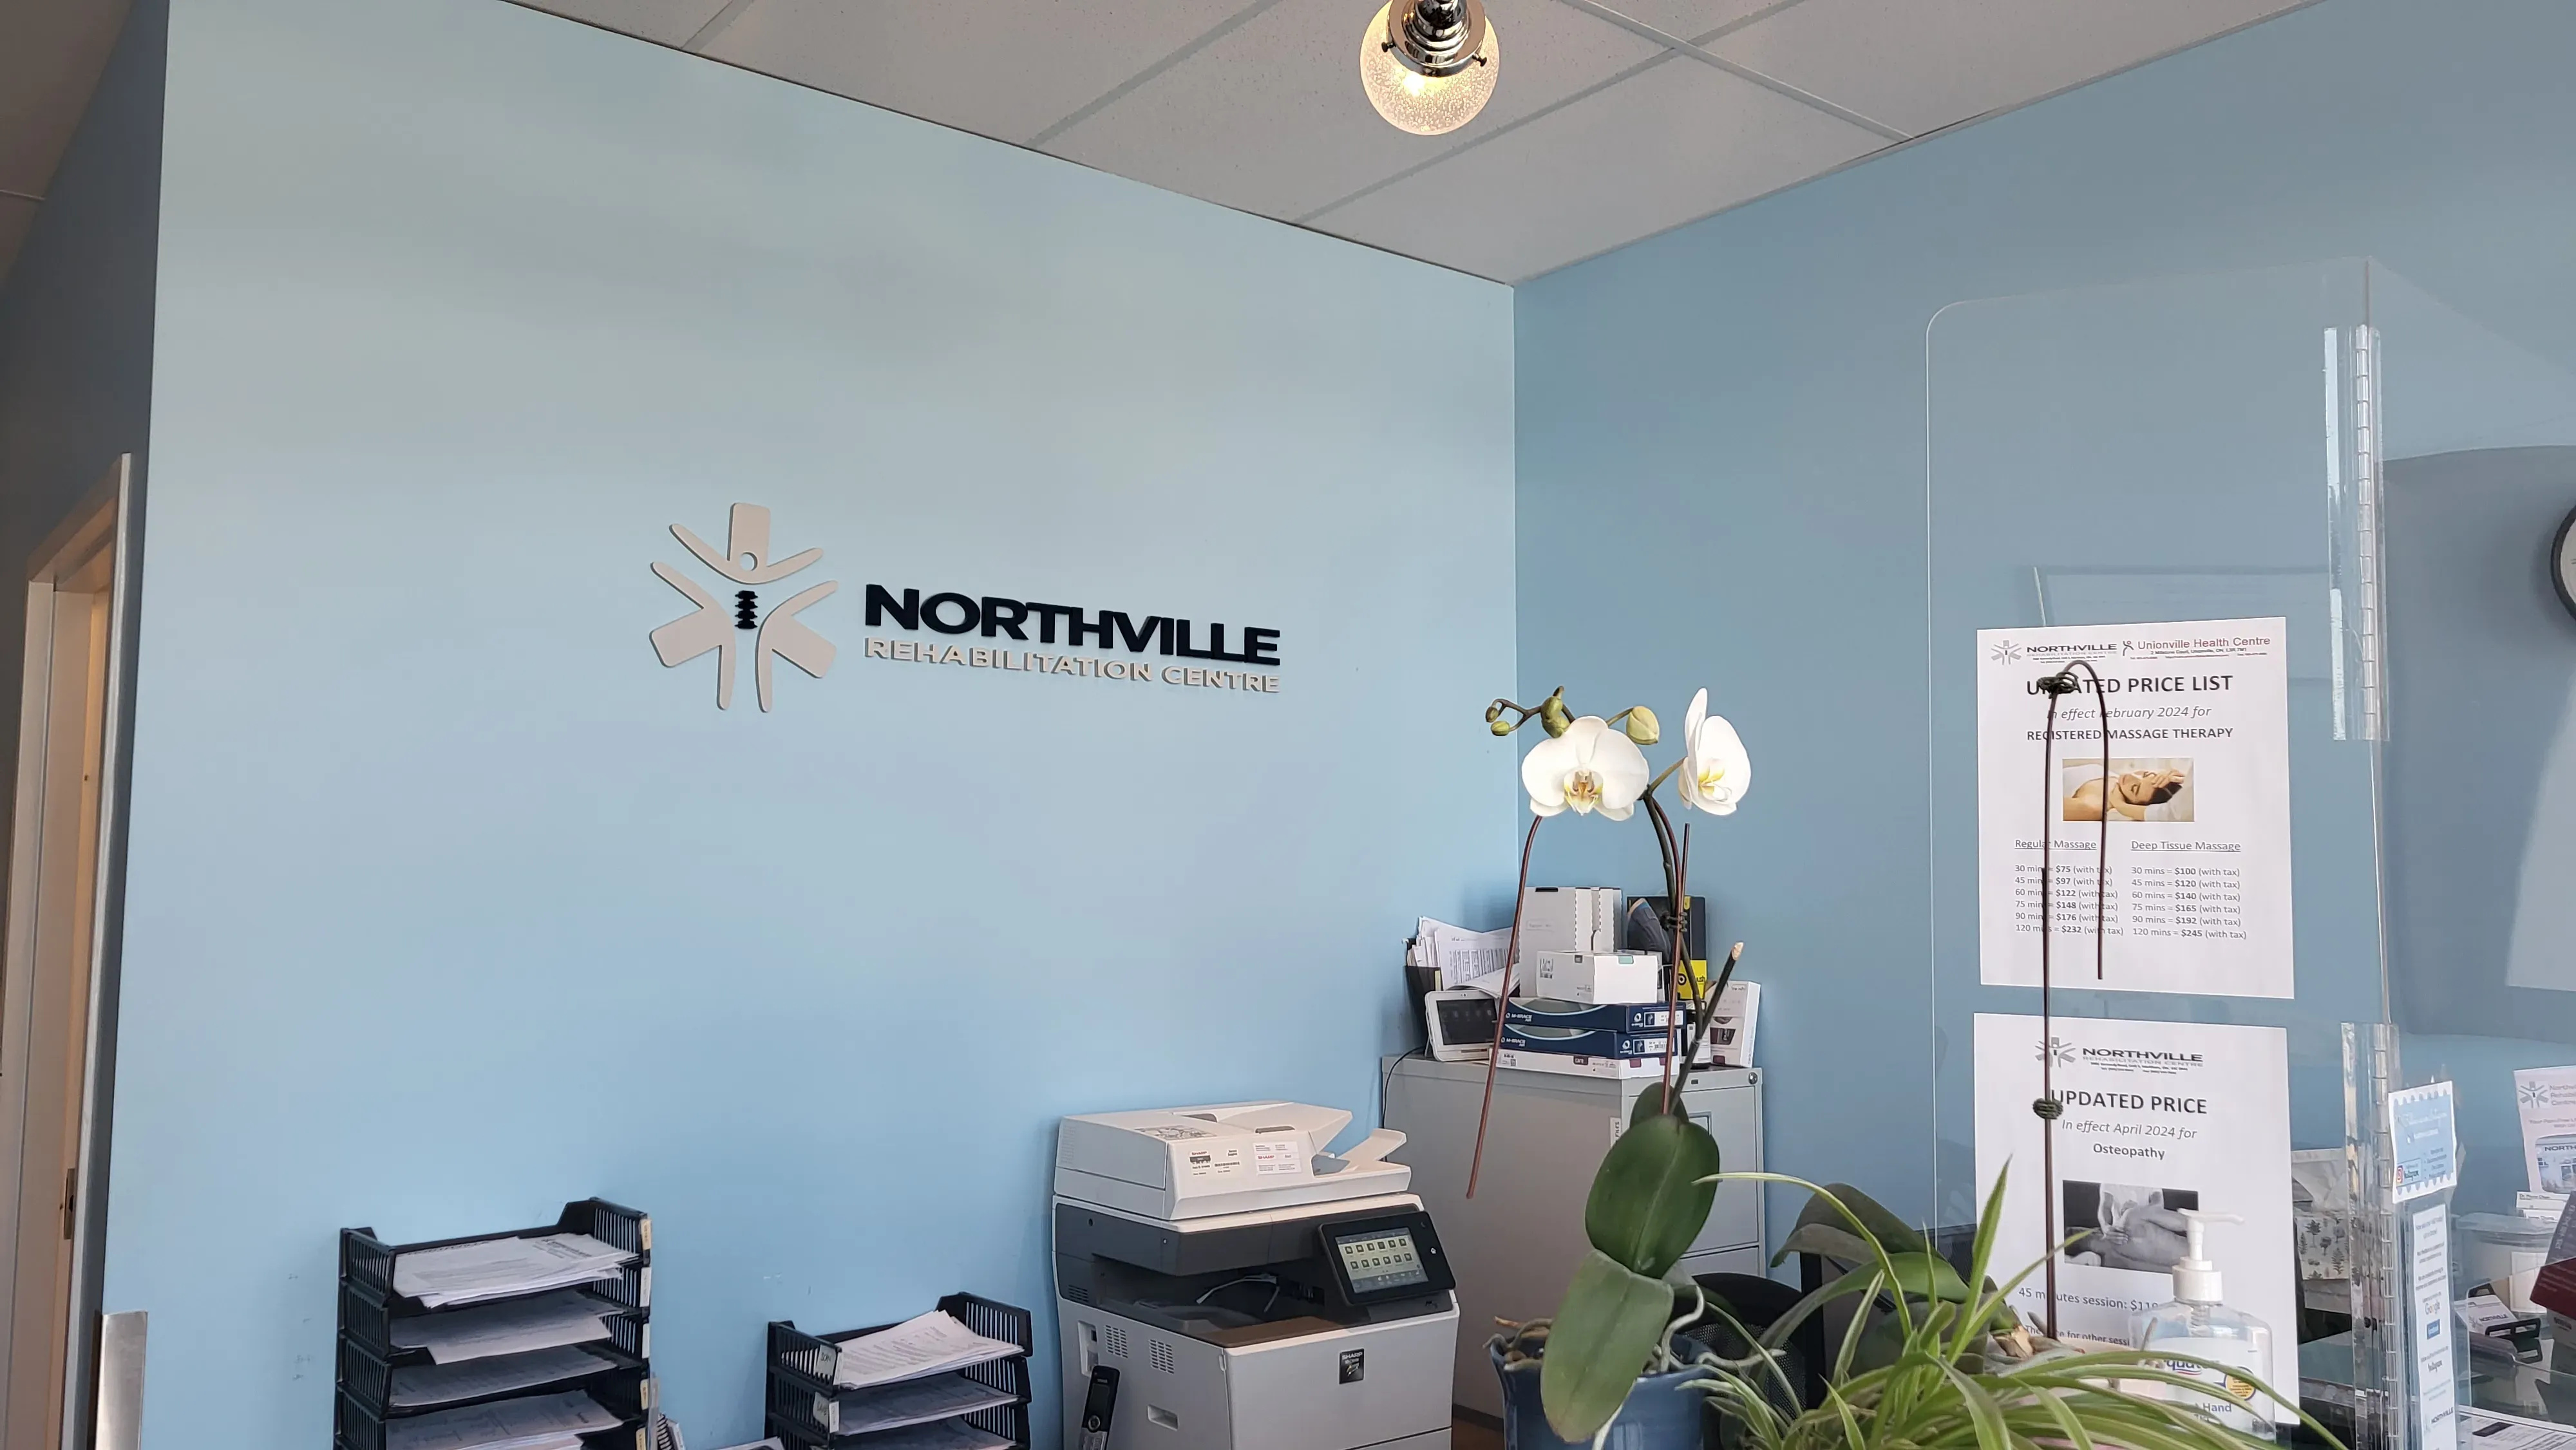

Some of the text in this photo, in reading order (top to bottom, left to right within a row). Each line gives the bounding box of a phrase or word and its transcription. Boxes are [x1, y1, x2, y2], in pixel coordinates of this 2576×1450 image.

[866, 584, 1280, 666] NORTHVILLE
[2027, 643, 2117, 652] NORTHVILLE
[2137, 637, 2271, 650] Unionville Health Centre
[865, 637, 1280, 693] REHABILITATION CENTRE
[2027, 675, 2233, 695] UTED PRICE LIST
[2061, 708, 2096, 720] effect
[2099, 707, 2154, 720] ebruary
[2157, 707, 2188, 717] 2024
[2190, 706, 2212, 719] for
[2107, 728, 2169, 740] MASSAGE
[2172, 728, 2233, 739] THERAPY
[2054, 840, 2097, 849] Massage
[2131, 841, 2241, 851] Deep Tissue Massage
[2056, 865, 2071, 873] $75
[2097, 866, 2112, 874] tx)
[2199, 868, 2221, 876] (with
[2223, 869, 2240, 877] tax)
[2056, 877, 2070, 885] $97
[2073, 878, 2094, 887] (with
[2199, 880, 2221, 889] (with
[2224, 881, 2240, 889] tax)
[2199, 892, 2221, 901] (with
[2224, 893, 2240, 901] tax)
[2200, 905, 2221, 914] (with
[2224, 905, 2240, 914] tax)
[2056, 913, 2077, 921] $176
[2175, 916, 2197, 925] $192
[2200, 918, 2222, 926] (with
[2224, 918, 2240, 927] tax)
[2108, 927, 2124, 936] tax)
[2206, 930, 2227, 939] (with
[2230, 930, 2247, 939] tax)
[2083, 1048, 2203, 1062] NORTHVILLE
[2083, 1056, 2162, 1065] REHABILITATION
[2052, 1089, 2208, 1114] UPDATED PRICE
[2061, 1119, 2197, 1140] In effect April 2024 for
[2093, 1143, 2165, 1160] Osteopathy
[2019, 1287, 2032, 1297] 45
[2035, 1290, 2080, 1303] mutes
[2082, 1295, 2128, 1308] session:
[1342, 1351, 1363, 1360] SHARP
[2202, 1402, 2233, 1413] Hand
